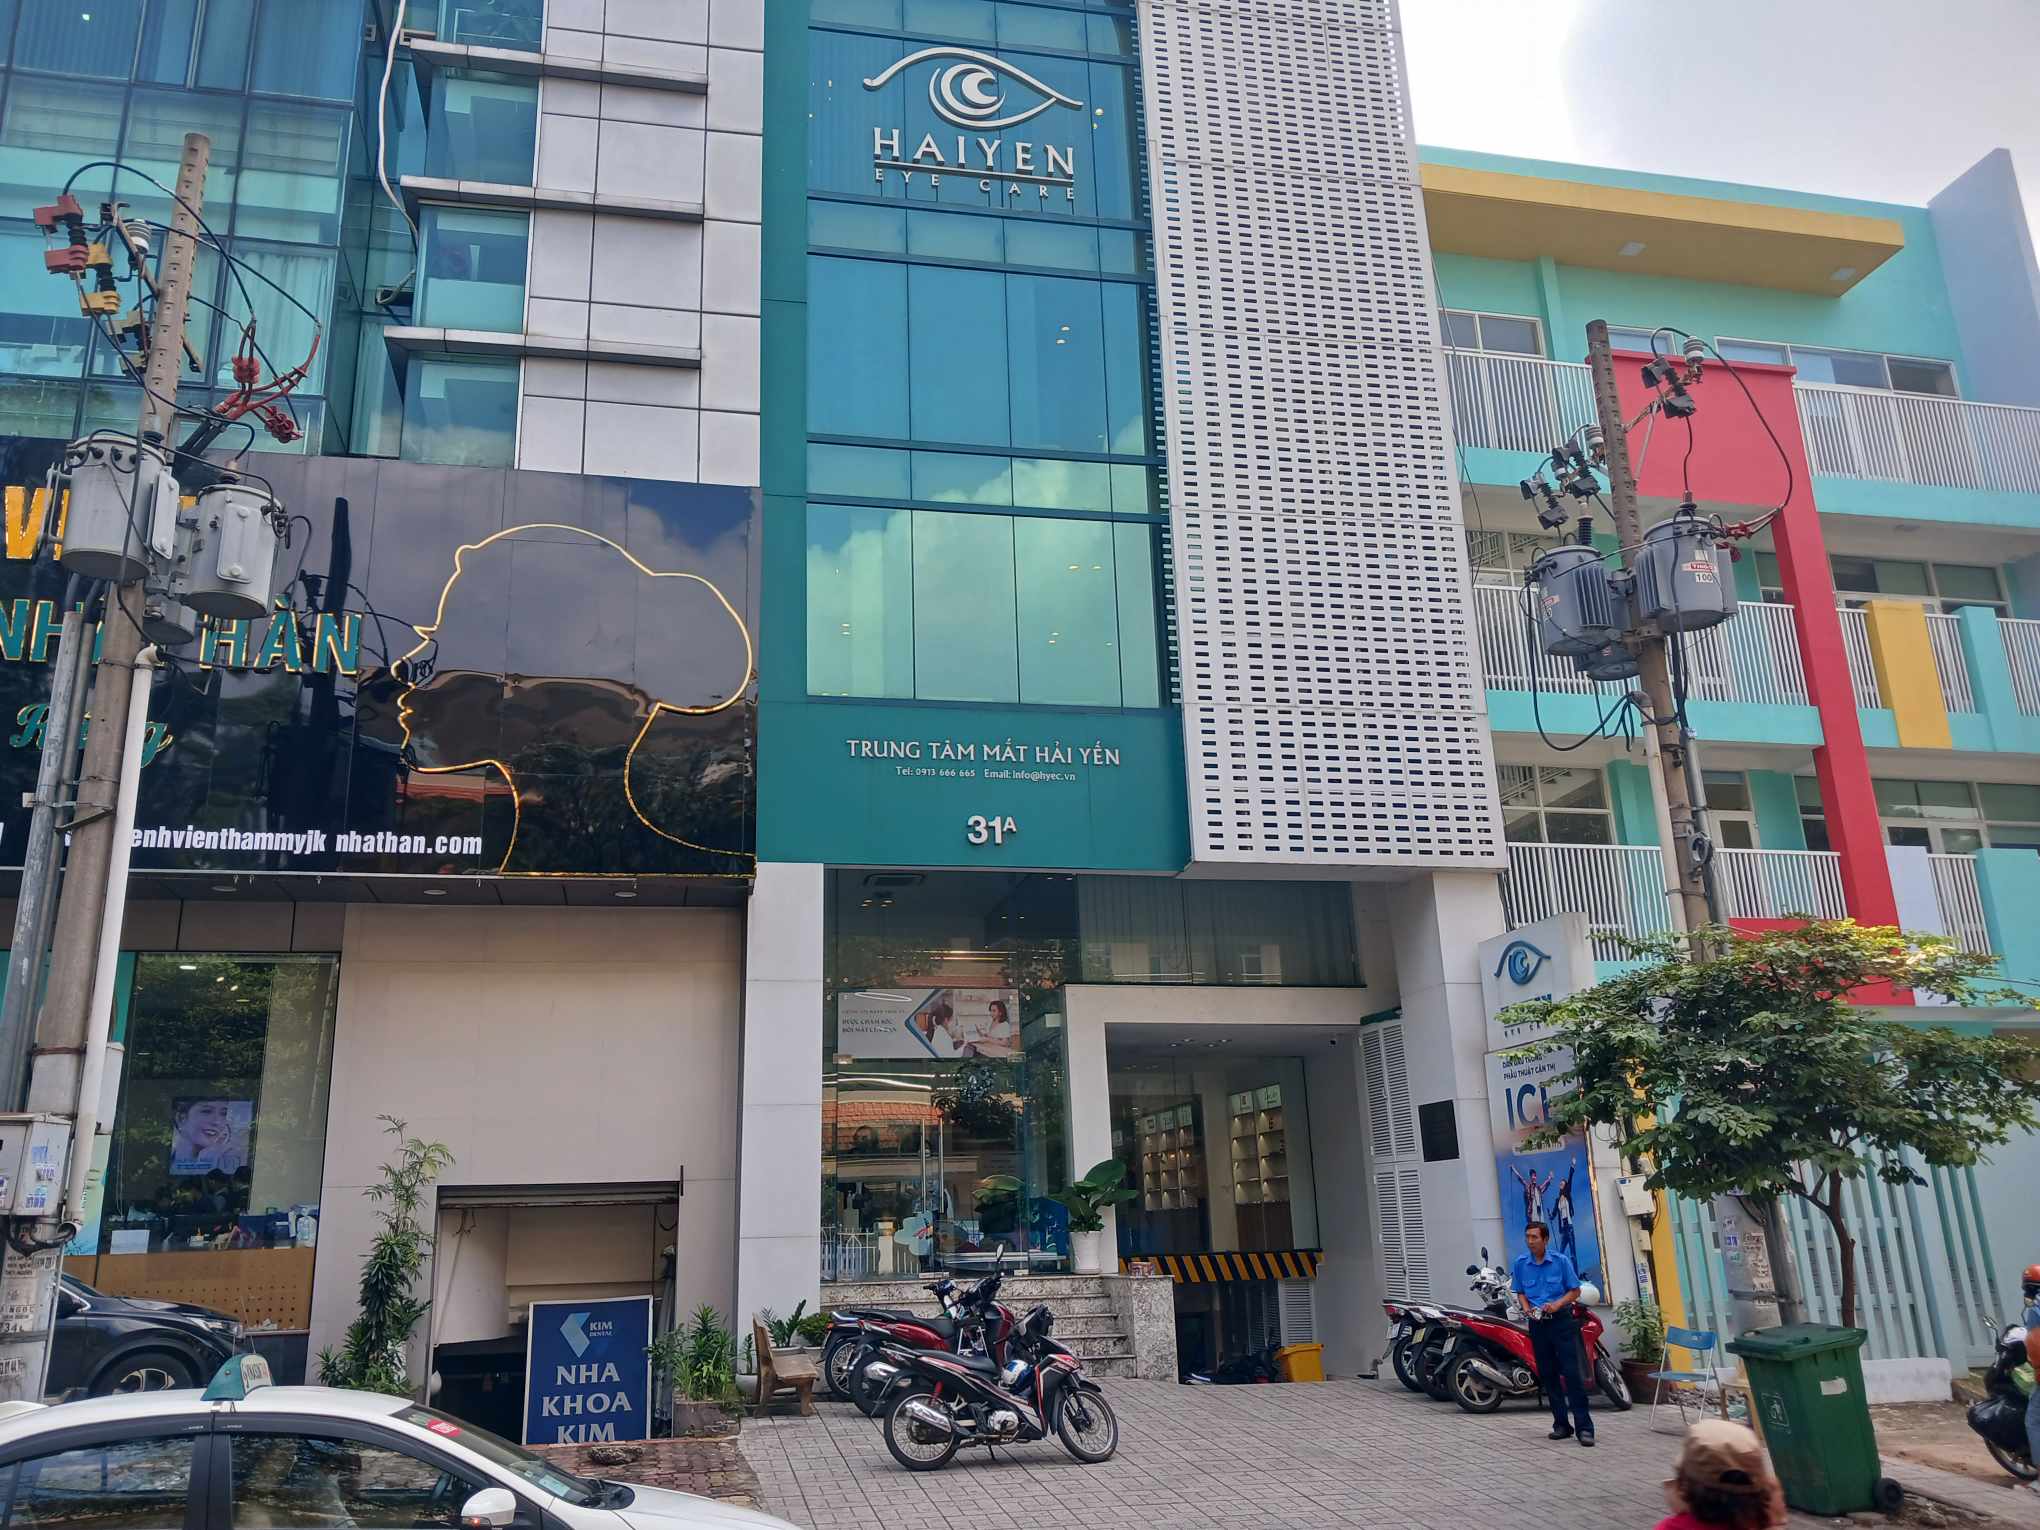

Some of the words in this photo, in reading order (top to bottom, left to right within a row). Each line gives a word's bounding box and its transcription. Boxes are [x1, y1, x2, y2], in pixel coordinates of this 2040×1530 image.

[874, 127, 1074, 175] HAIYEN
[875, 168, 940, 186] EYE
[979, 179, 1075, 200] CARE
[846, 739, 920, 759] TRUNG
[928, 739, 975, 760] TÂM
[982, 737, 1028, 762] MẮT
[1035, 740, 1072, 764] HẢI
[1078, 740, 1120, 766] YẾN
[896, 766, 913, 776] Tel:
[915, 768, 936, 776] 0913
[939, 769, 956, 777] 666
[958, 769, 976, 777] 665
[984, 769, 1011, 779] Email:
[589, 1320, 613, 1332] KIM
[556, 1362, 621, 1386] NHA
[542, 1391, 632, 1417] KHOA
[557, 1422, 616, 1444] KIM
